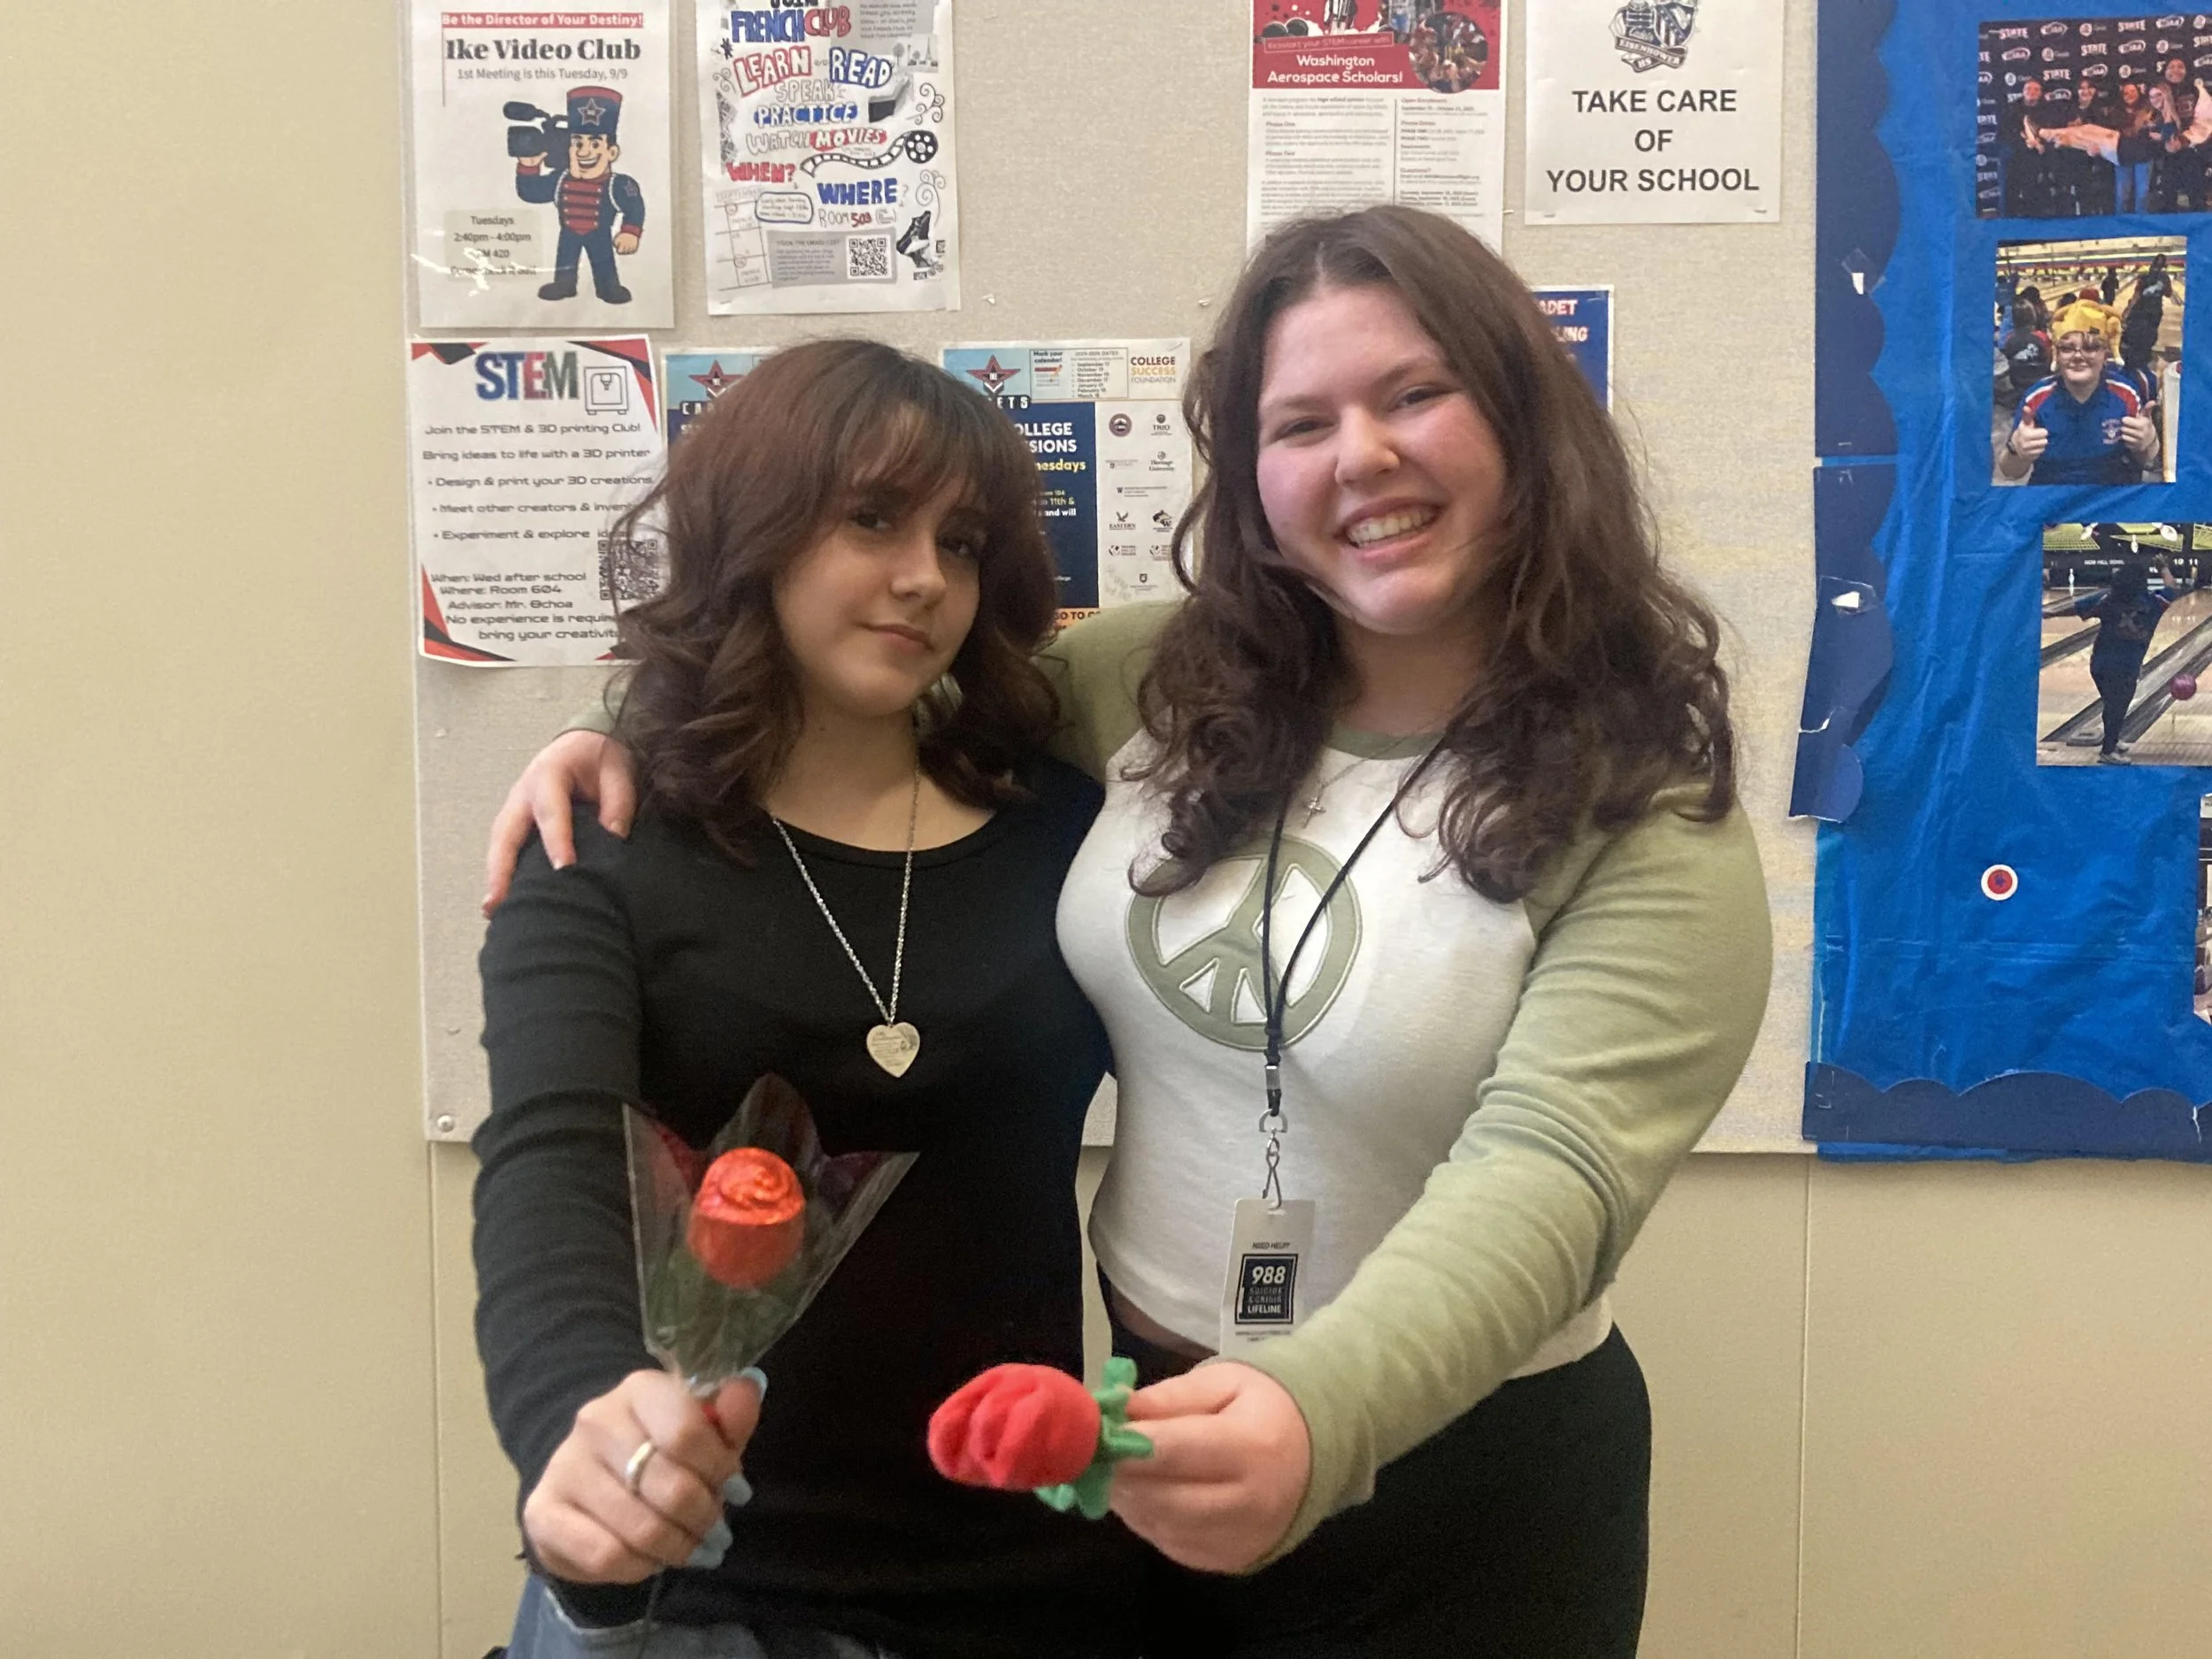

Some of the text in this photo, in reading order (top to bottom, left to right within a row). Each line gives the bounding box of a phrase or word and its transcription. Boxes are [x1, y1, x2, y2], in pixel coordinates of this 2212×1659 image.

[462, 14, 483, 25] the
[487, 14, 538, 25] Director
[541, 14, 555, 25] of
[557, 14, 587, 25] Your
[590, 14, 642, 27] Destiny!
[731, 10, 805, 42] FRENCH
[803, 6, 851, 37] CLUB
[446, 38, 641, 60] Ike Video Club
[1296, 54, 1375, 70] Washington
[457, 68, 627, 81] 1st Meeting is this Tuesday, 9/9
[733, 46, 894, 97] LEARN READ
[1267, 71, 1402, 85] Aerospace Scholars!
[774, 80, 839, 103] SPEAK
[1571, 89, 1737, 112] TAKE CARE
[756, 103, 857, 128] PRACTICE
[746, 130, 810, 155] WATCH
[811, 129, 887, 152] MOVIES
[1634, 129, 1672, 152] OF
[726, 161, 795, 183] WHEN?
[1546, 168, 1759, 192] YOUR SCHOOL
[471, 215, 514, 226] Tuesdays
[818, 209, 849, 227] ROOM
[454, 233, 488, 244] 2:40pm
[496, 232, 531, 243] 4:00pm
[1539, 299, 1578, 315] ADET
[1130, 356, 1176, 366] COLLEGE
[475, 351, 579, 400] STEM
[1131, 366, 1176, 376] SUCCESS
[425, 423, 641, 435] Join the STEM & 3D printing Club!
[1014, 422, 1072, 436] OLLEGE
[1028, 439, 1078, 453] SIONS
[423, 450, 458, 462] Bring
[462, 449, 497, 460] ideas
[518, 449, 538, 459] life
[541, 449, 567, 458] with
[583, 449, 602, 458] 3D
[605, 449, 650, 459] printer
[1034, 458, 1086, 472] nesdays
[436, 478, 480, 488] Design
[484, 478, 494, 487] &
[498, 476, 530, 488] print
[533, 478, 565, 488] your
[567, 476, 587, 486] 3D
[440, 503, 473, 513] Meet
[477, 503, 514, 513] other
[518, 503, 577, 512] creators
[580, 503, 590, 512] &
[1061, 507, 1077, 517] will
[442, 529, 590, 541] Experiment & explore
[431, 572, 586, 583] When: Wed after school
[440, 585, 562, 595] Where: Room 604
[449, 600, 502, 610] Advisor:
[505, 600, 526, 609] Mr.
[446, 613, 617, 626] No experience is requir
[479, 629, 515, 642] bring
[518, 630, 551, 642] your
[1252, 1265, 1286, 1285] 988
[1247, 1304, 1282, 1314] LIFELINE
